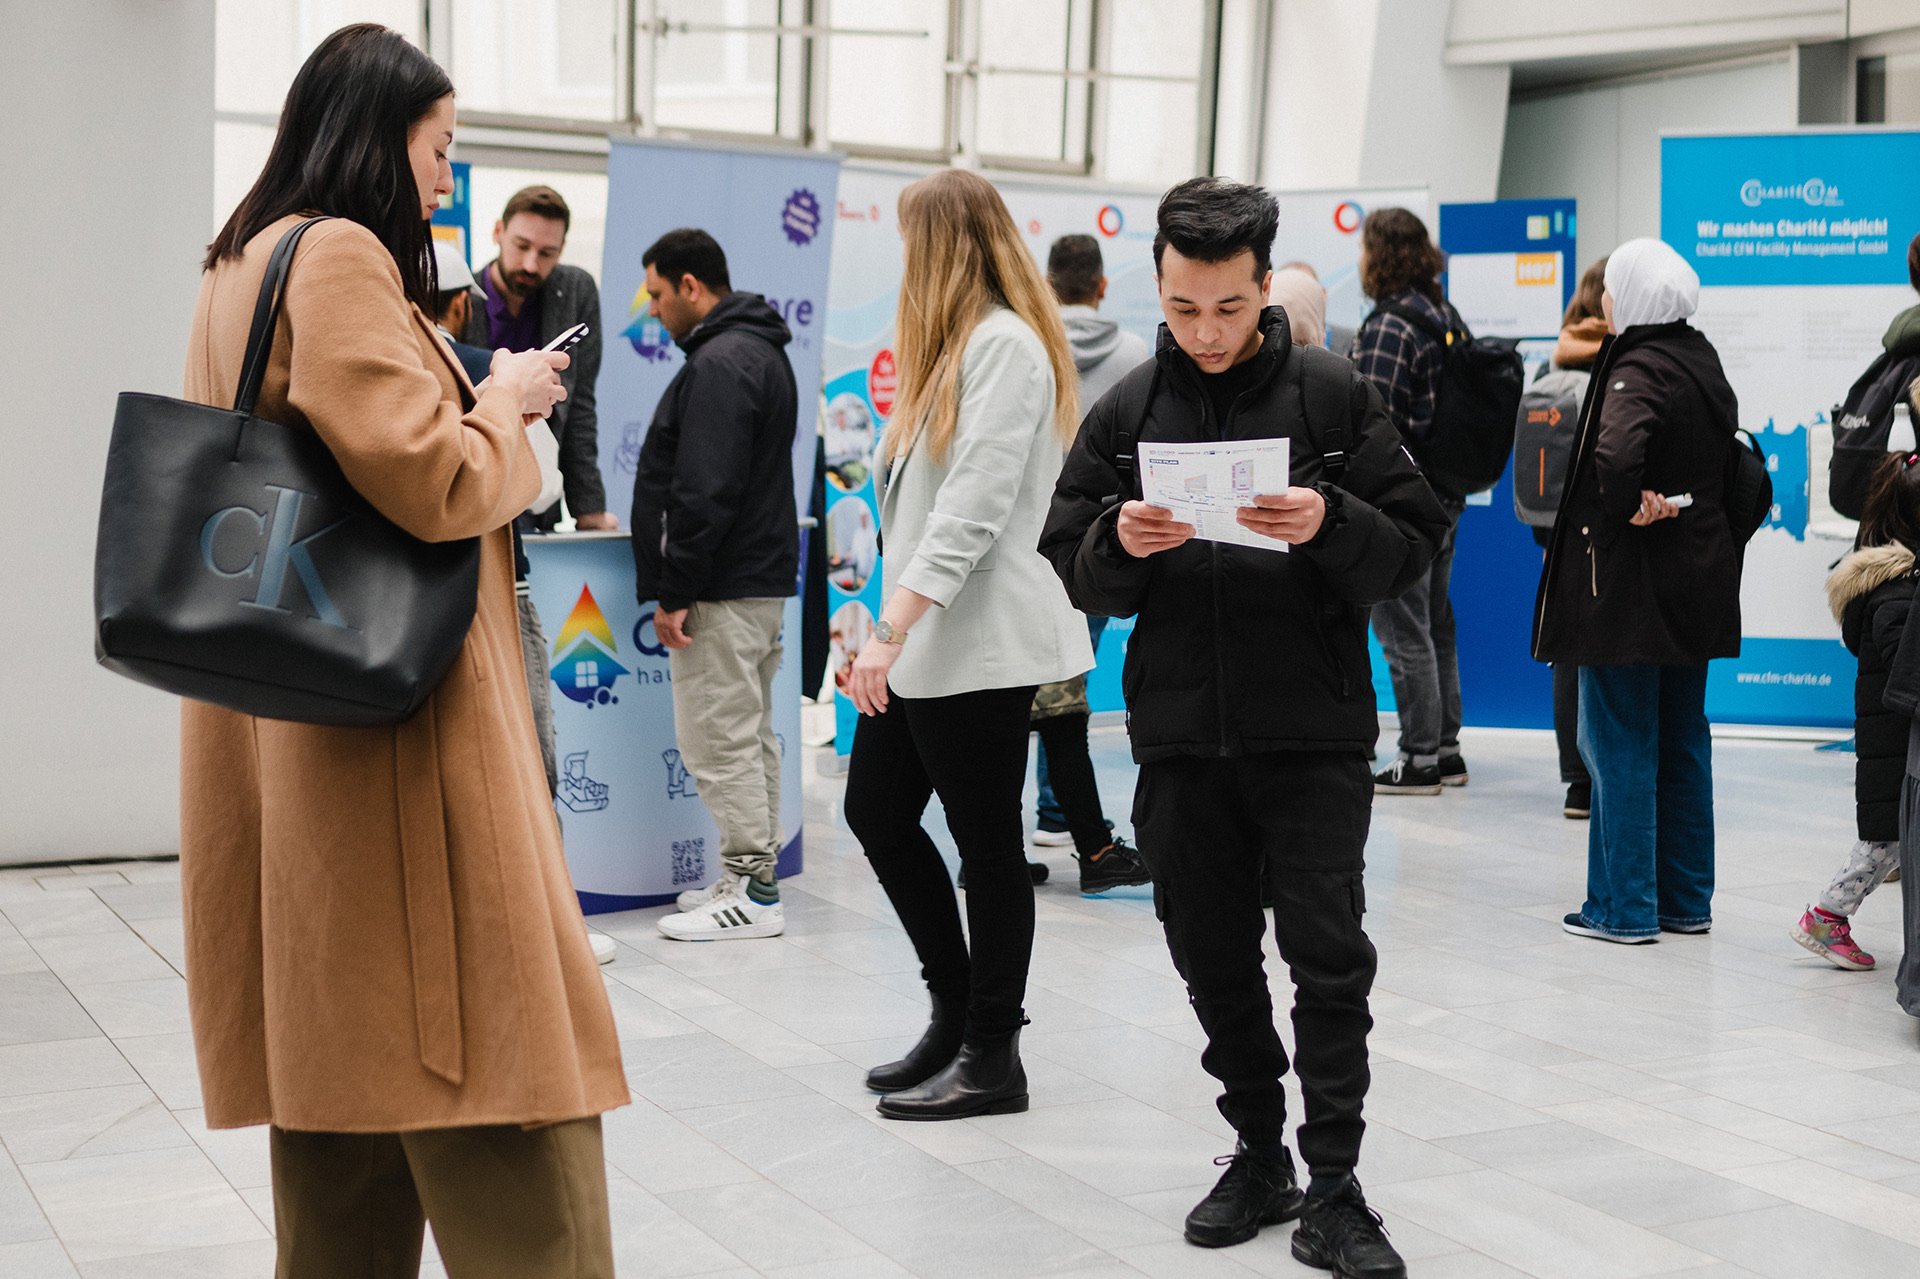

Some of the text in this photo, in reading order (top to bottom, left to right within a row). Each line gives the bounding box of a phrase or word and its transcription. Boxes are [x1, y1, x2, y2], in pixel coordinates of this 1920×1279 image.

[1697, 217, 1888, 239] Wir machen Charité möglich!
[1696, 240, 1888, 257] Charité CFM Facility Management GmbH
